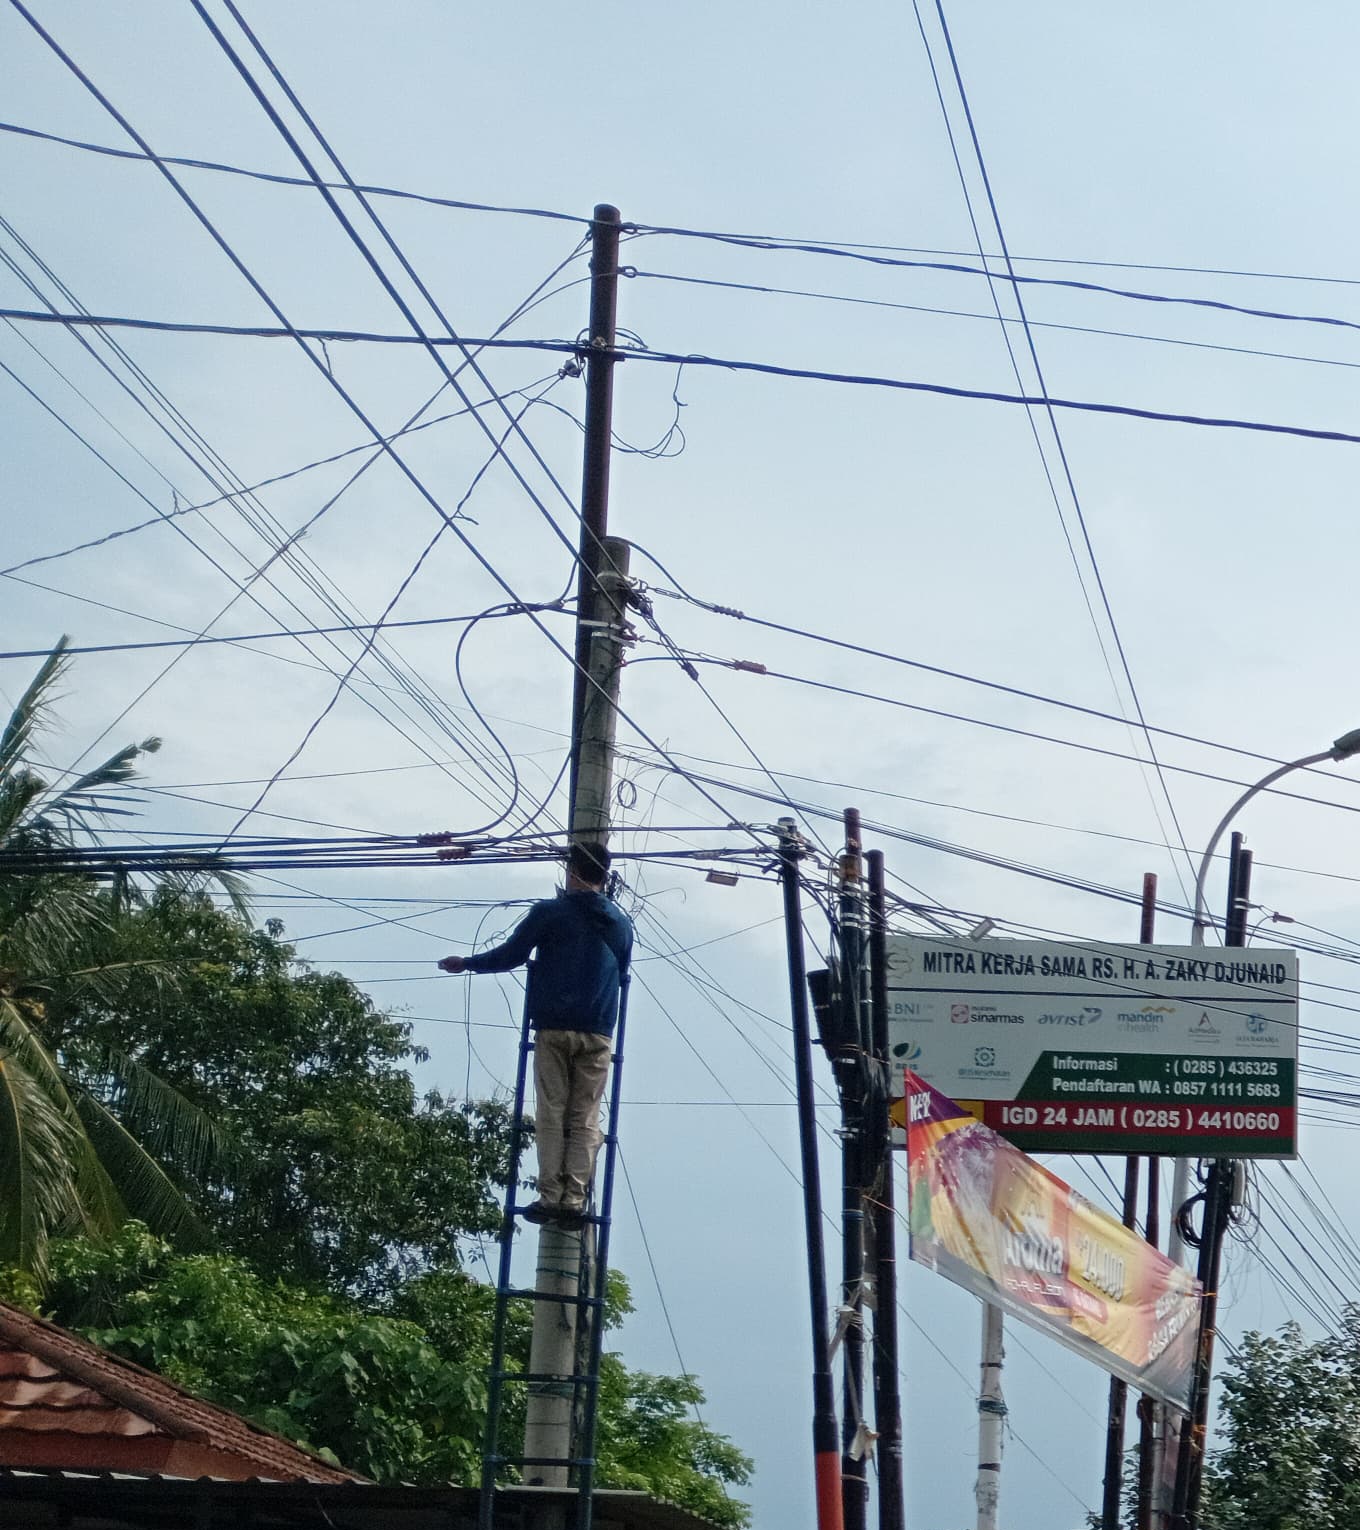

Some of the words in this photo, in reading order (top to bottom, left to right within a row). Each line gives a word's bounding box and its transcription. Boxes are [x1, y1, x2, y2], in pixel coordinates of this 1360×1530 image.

[924, 951, 975, 974] MITRA
[981, 953, 1035, 976] KERJA
[1040, 955, 1087, 978] SAMA
[1092, 957, 1118, 979] RS.
[1124, 958, 1139, 980] H.
[1145, 958, 1160, 980] A.
[1165, 959, 1210, 982] ZAKY
[1214, 961, 1286, 984] DJUNAID
[894, 1003, 920, 1015] BNI
[971, 1011, 1025, 1024] sinarmas
[1038, 1012, 1085, 1026] avrist
[1052, 1055, 1118, 1071] Informasi
[1183, 1060, 1216, 1074] 0285
[1228, 1061, 1278, 1076] 436325
[1052, 1077, 1135, 1093] Pendaftaran
[1139, 1080, 1161, 1094] WA
[1173, 1081, 1206, 1095] 0857
[1210, 1082, 1242, 1096] 1111
[1247, 1083, 1280, 1097] 5683
[1002, 1106, 1038, 1125] IGD
[1043, 1107, 1067, 1125] 24
[1072, 1108, 1115, 1126] JAM
[1133, 1109, 1180, 1128] 0285
[1198, 1111, 1280, 1130] 4410660
